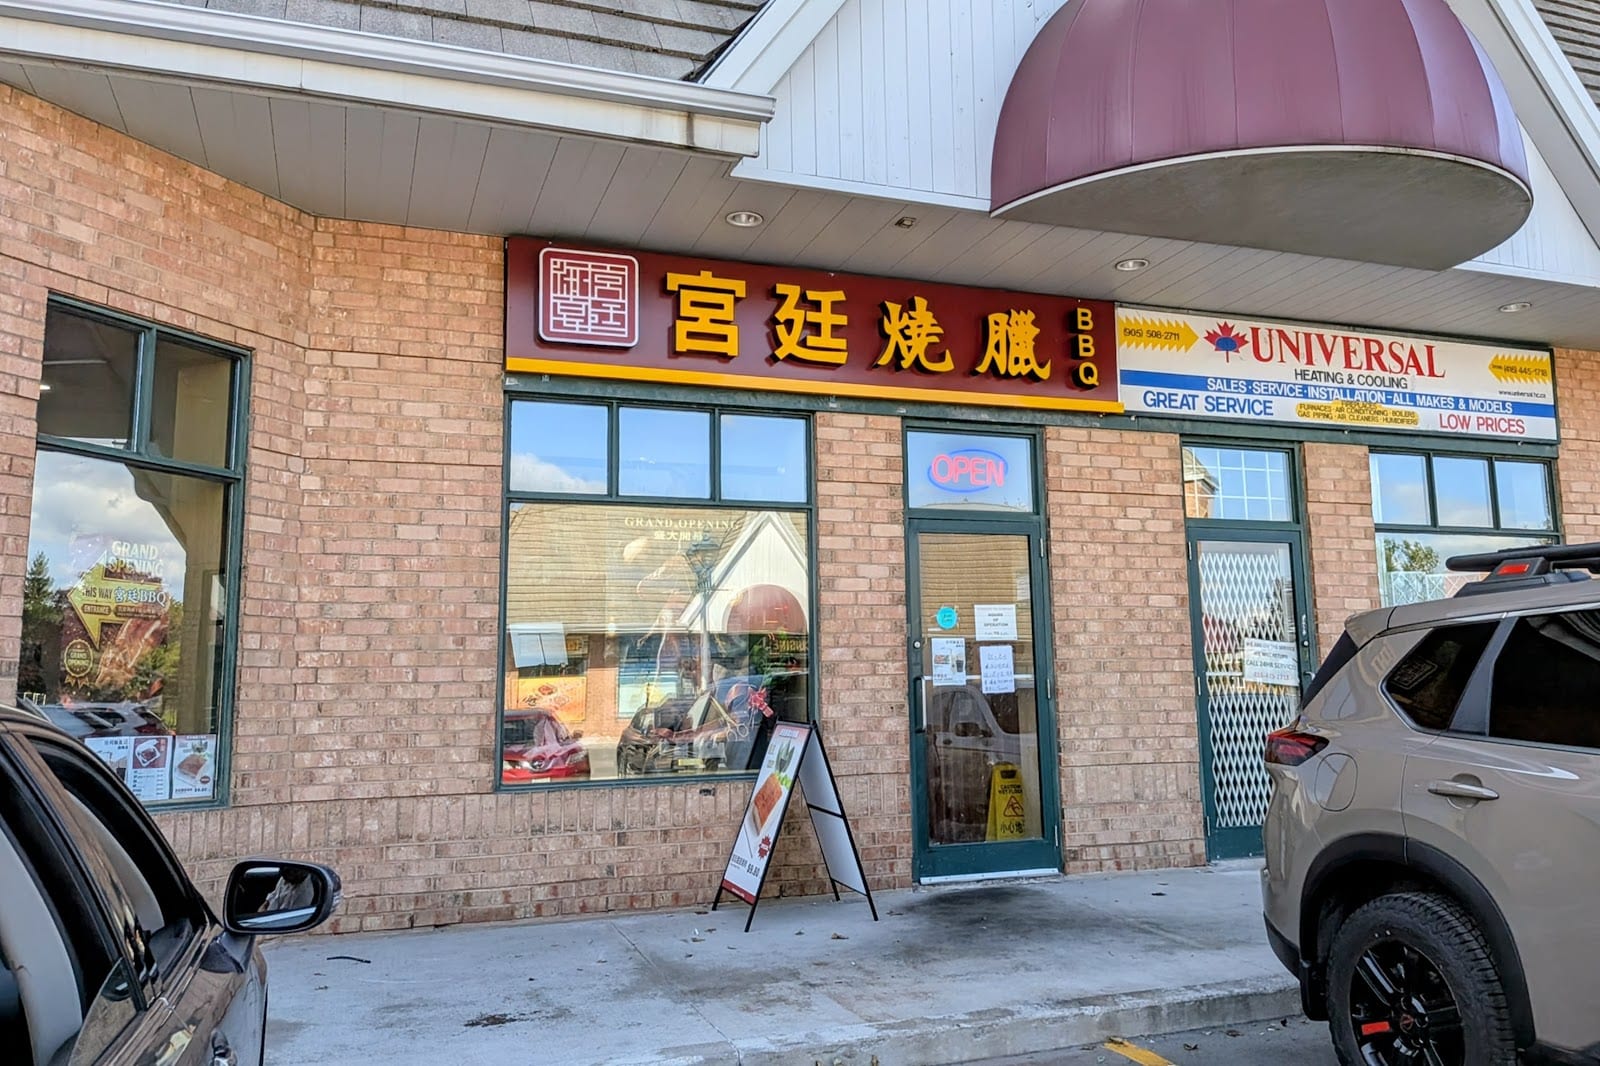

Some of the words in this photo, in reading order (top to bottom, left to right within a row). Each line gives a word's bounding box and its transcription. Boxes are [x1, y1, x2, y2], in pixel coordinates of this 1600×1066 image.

[666, 270, 1051, 380] 宮廷燒臘
[1123, 327, 1143, 337] (905)
[1146, 329, 1180, 341] 508-2711
[1077, 307, 1099, 386] BBQ
[1250, 326, 1446, 379] UNIVERSAL
[1294, 368, 1344, 385] HEATING
[1347, 373, 1355, 385] &
[1357, 374, 1408, 389] COOLING
[1143, 389, 1199, 411] GREAT
[1204, 395, 1274, 416] SERVICE
[1207, 377, 1247, 392] SALES
[1252, 381, 1303, 397] SERVICE
[1307, 386, 1385, 404] INSTALLATION
[1393, 394, 1414, 406] ALL
[1416, 396, 1454, 409] MAKES
[1458, 398, 1466, 410] &
[1469, 399, 1513, 414] MODELS
[1346, 407, 1388, 417] CONDITIONING
[1439, 413, 1471, 431] LOW
[1476, 416, 1525, 434] PRICES
[931, 453, 1005, 488] OPEN
[624, 516, 673, 528] GRAND
[111, 540, 159, 561] GRAND
[98, 587, 113, 599] WAY
[139, 589, 167, 607] BBQ
